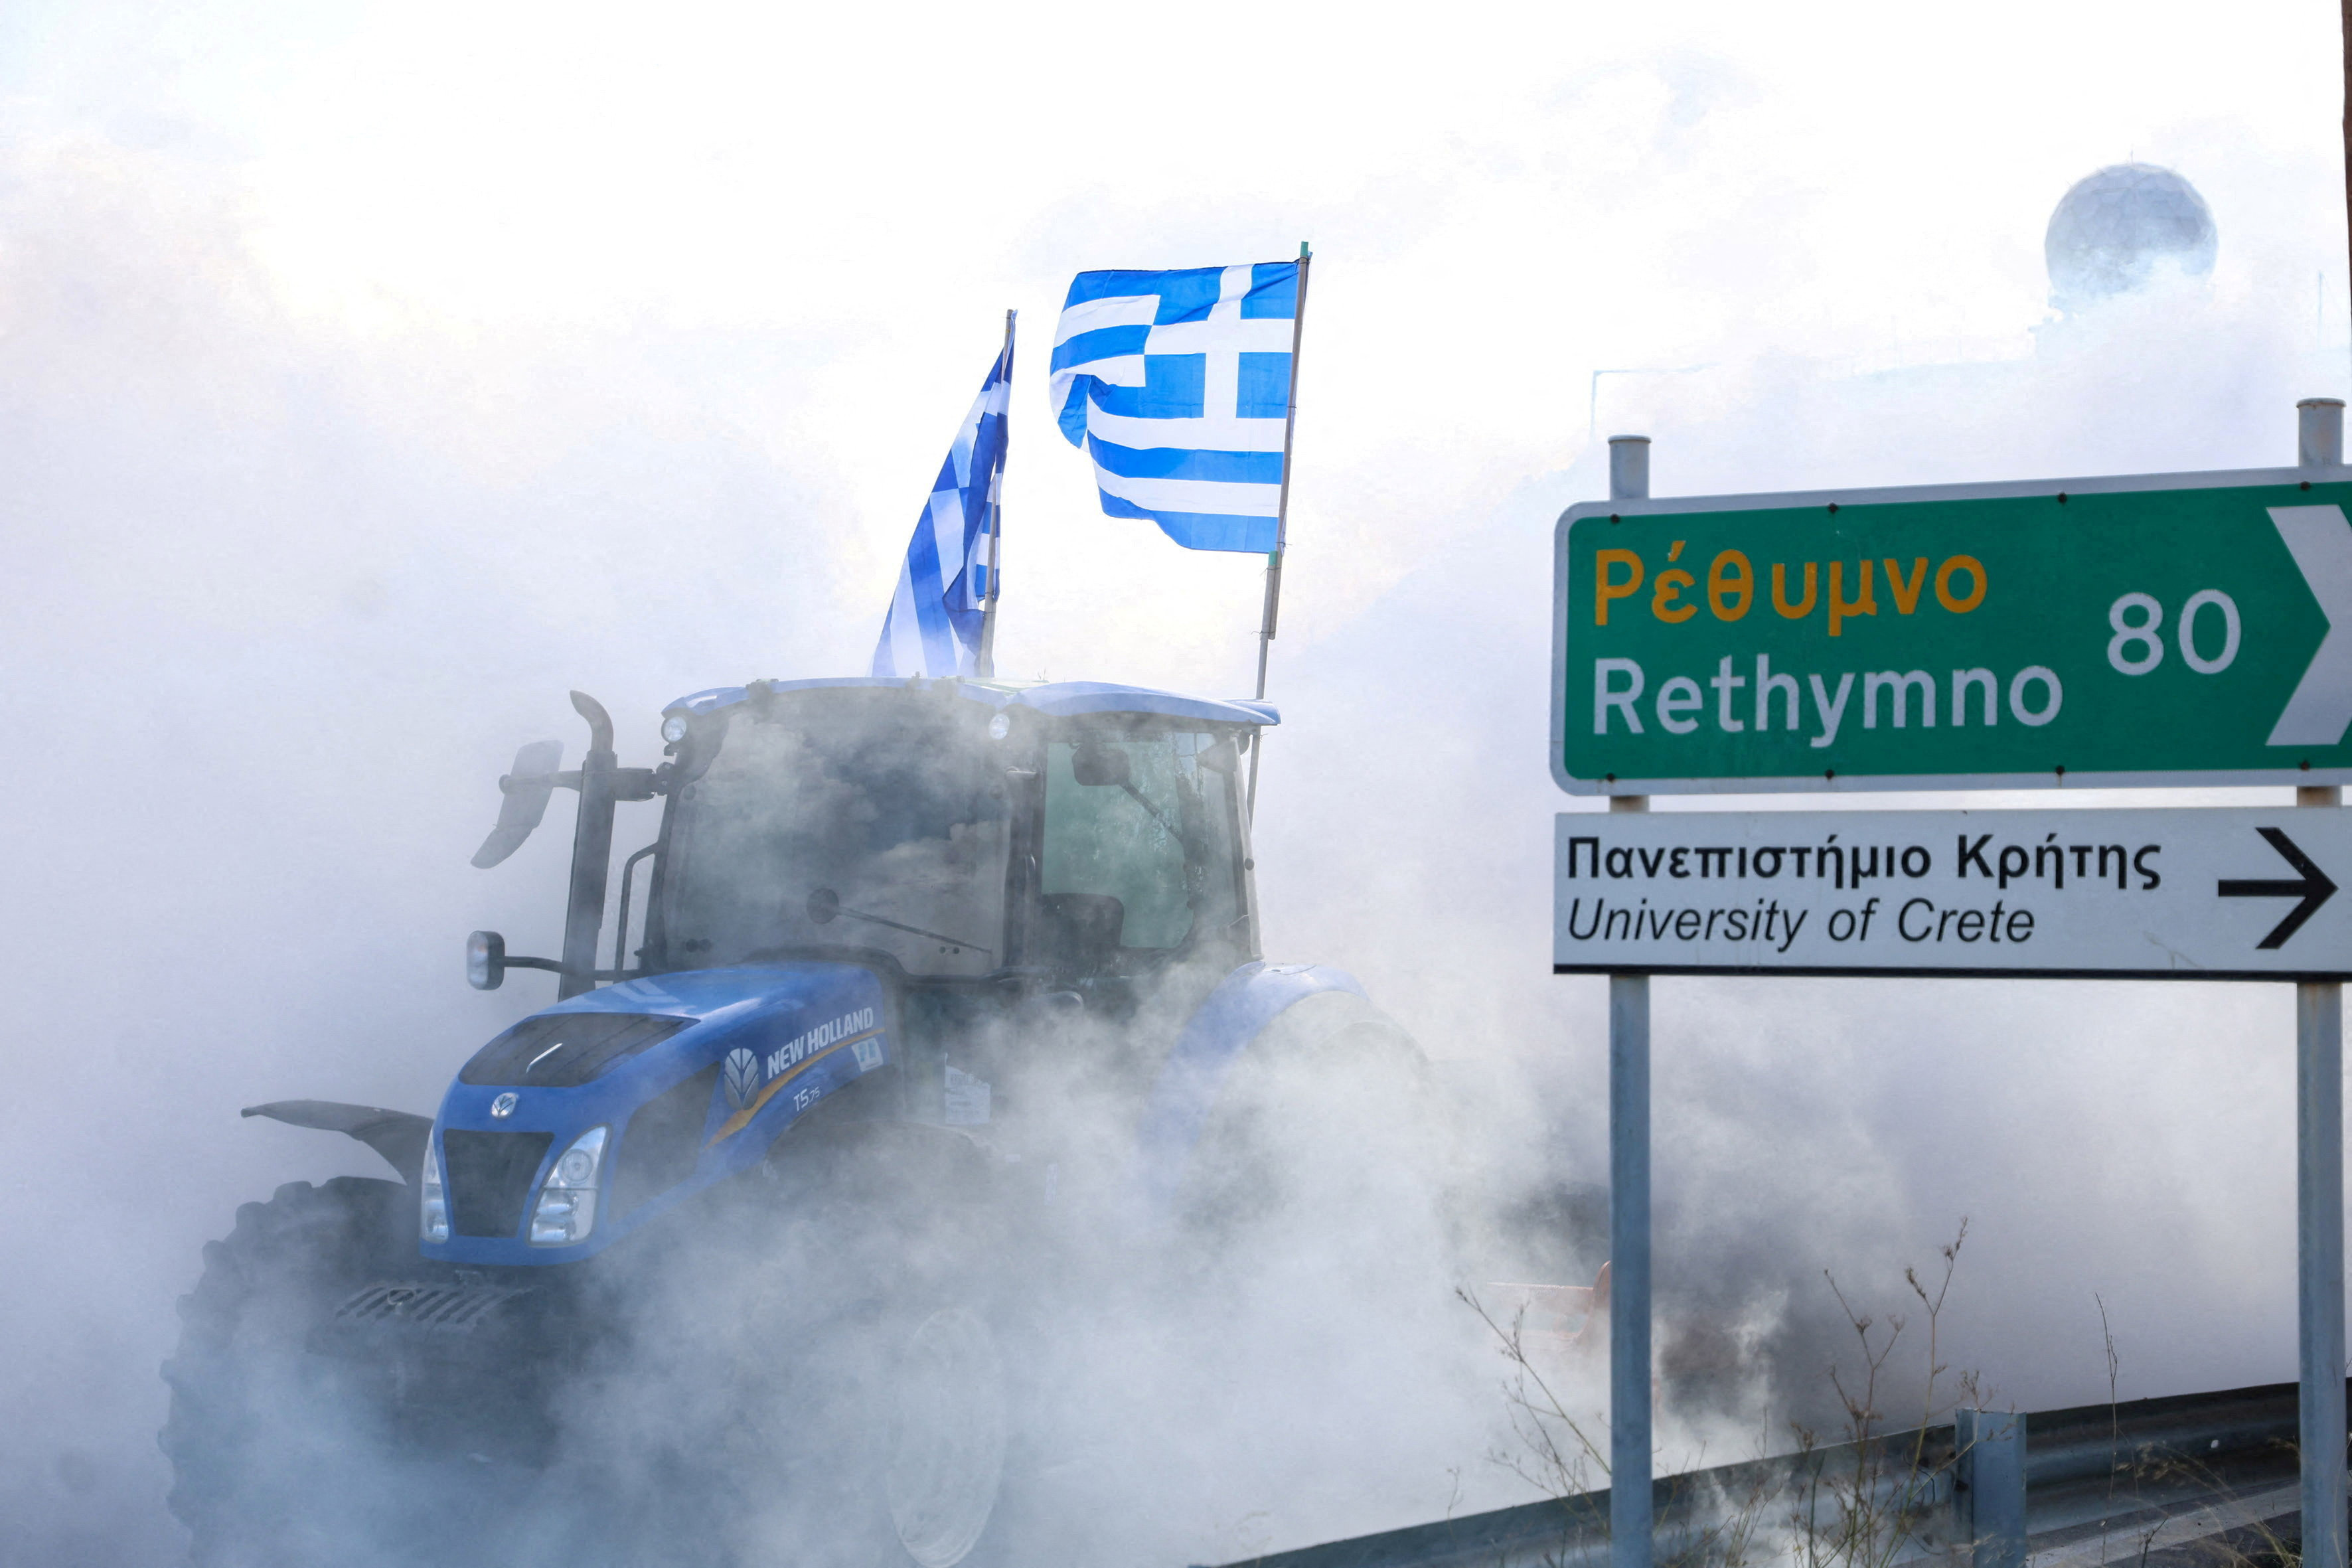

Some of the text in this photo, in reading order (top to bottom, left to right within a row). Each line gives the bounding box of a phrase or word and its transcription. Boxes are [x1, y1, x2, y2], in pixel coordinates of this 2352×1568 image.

[1595, 540, 1988, 637] Ρέθυμνο
[2106, 588, 2242, 676] 80
[1594, 653, 2063, 749] Rethymno
[1567, 832, 2163, 892] Πανεπιστήμιο Κρήτης
[1568, 897, 2036, 954] University of Crete
[767, 1007, 874, 1079] NEW HOLLAND
